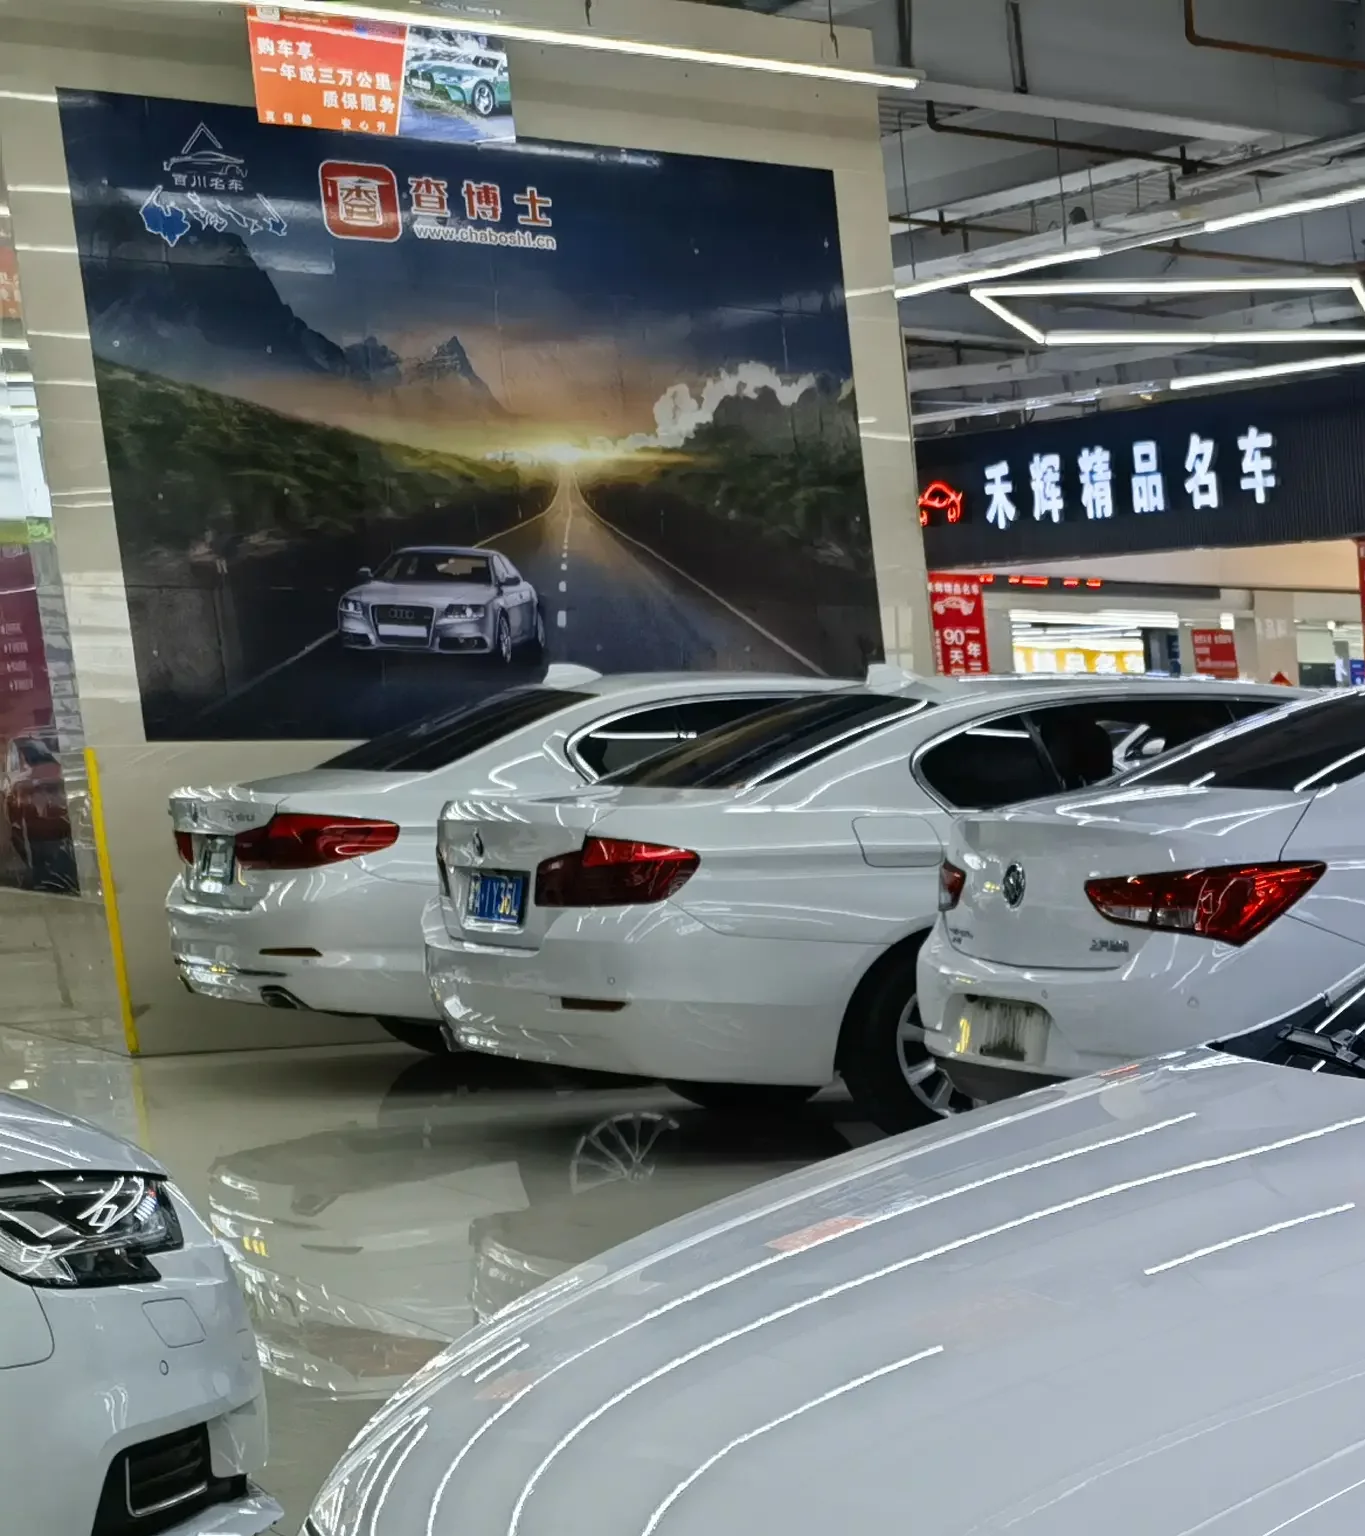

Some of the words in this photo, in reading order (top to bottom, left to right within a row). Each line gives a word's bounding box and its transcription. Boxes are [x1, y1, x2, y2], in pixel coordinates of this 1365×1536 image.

[257, 37, 313, 59] 购车享
[260, 64, 392, 91] 一年或三万公里
[408, 176, 553, 228] 查博士
[412, 224, 556, 251] www.chaboshi.cn
[985, 427, 1276, 529] 禾辉精品名车
